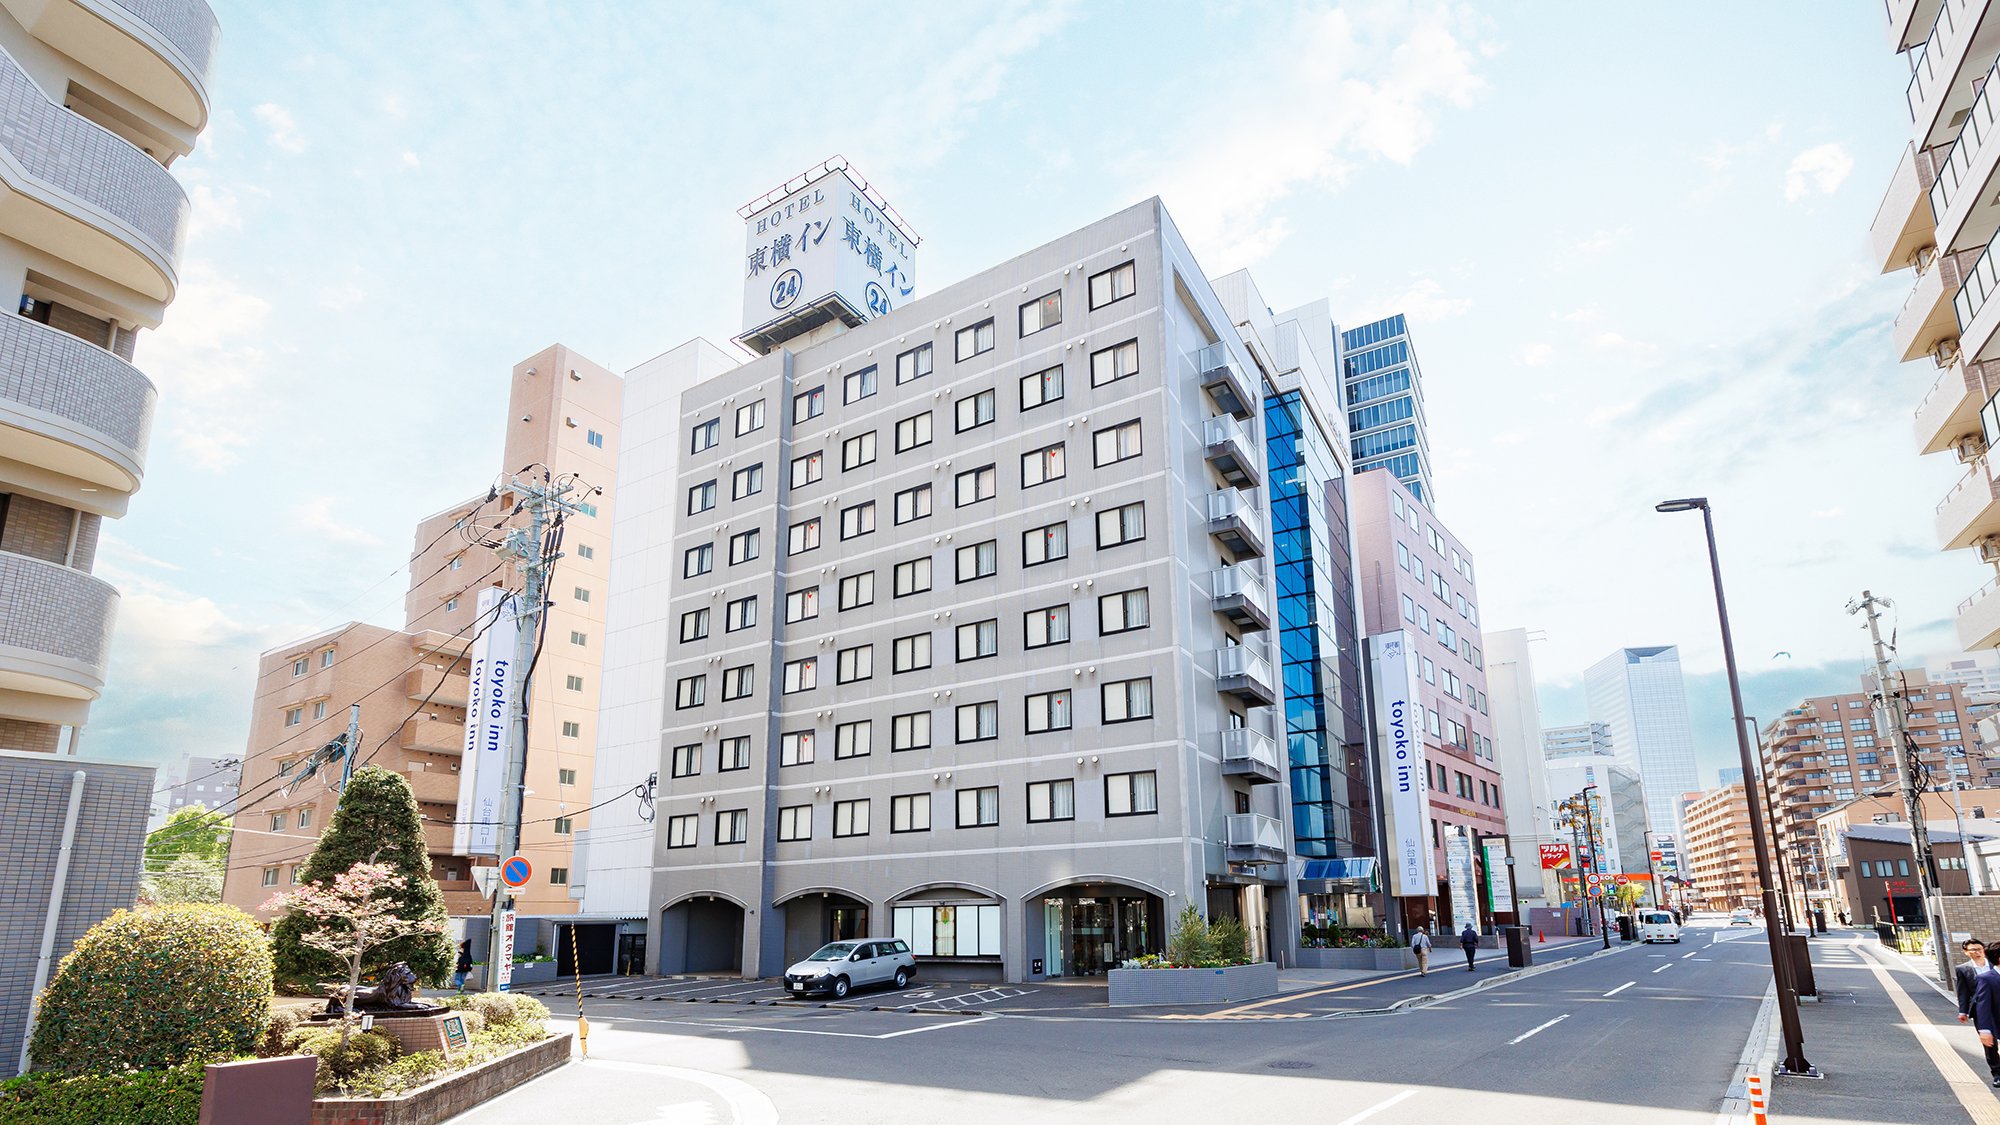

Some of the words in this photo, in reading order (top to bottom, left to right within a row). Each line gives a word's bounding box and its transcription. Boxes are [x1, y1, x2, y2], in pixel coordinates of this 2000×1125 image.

[756, 188, 825, 235] HOTEL
[849, 191, 909, 260] HOTEL
[746, 216, 833, 280] 東横イン
[840, 215, 914, 296] 東横イン
[775, 275, 797, 305] 24
[869, 289, 888, 315] 24
[470, 658, 485, 719] toyoko
[491, 660, 509, 719] toyoko
[467, 723, 480, 751] inn
[487, 724, 505, 752] inn
[1391, 700, 1406, 760] toyoko
[1397, 766, 1411, 792] inn
